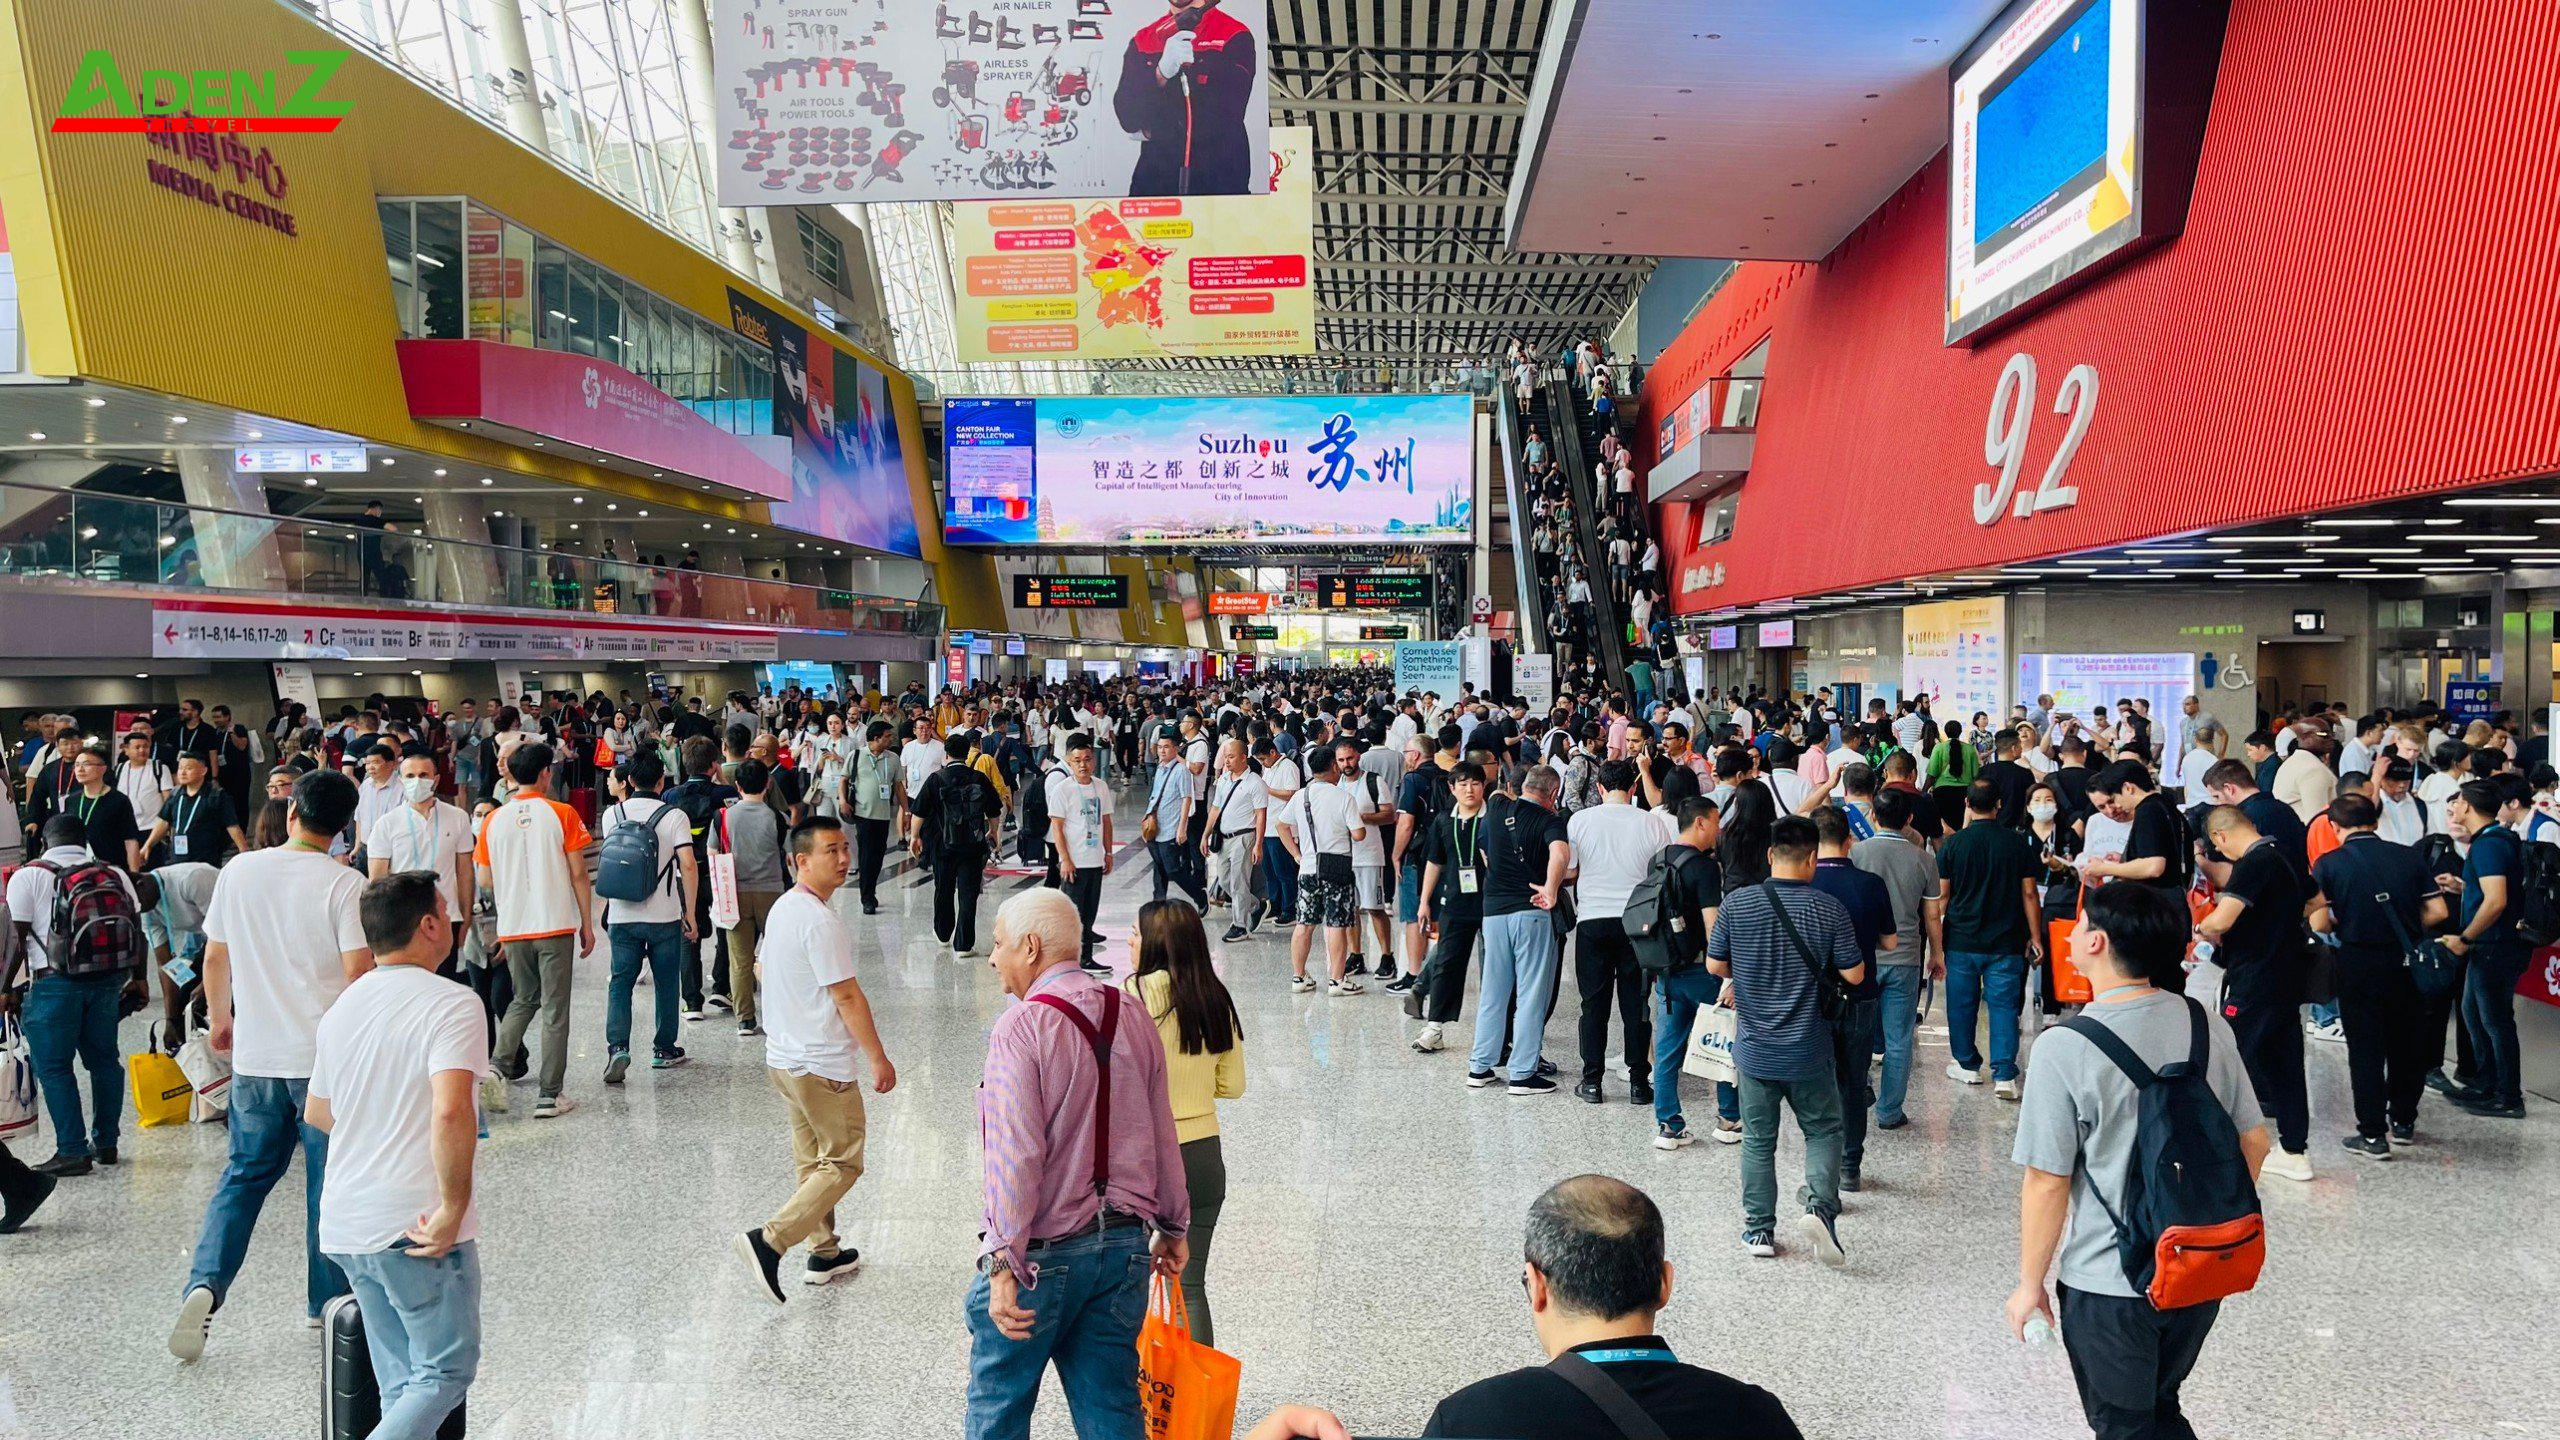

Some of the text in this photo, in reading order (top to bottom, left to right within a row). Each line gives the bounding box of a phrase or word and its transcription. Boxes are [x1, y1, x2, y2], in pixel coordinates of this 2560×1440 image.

[993, 1, 1051, 11] AIR NAILER
[788, 8, 848, 18] SPRAY GUN
[984, 59, 1029, 68] AIRLESS
[983, 71, 1034, 81] SPRAYER
[790, 98, 844, 107] AIR TOOLS
[780, 110, 854, 119] POWER TOOLS
[147, 159, 297, 237] MEDIA CENTRE
[1971, 351, 2101, 526] 9.2
[1307, 413, 1416, 494] 苏州
[1093, 459, 1289, 480] 智造之都 创新之城
[1095, 481, 1242, 493] Capital of Intelligent Manufacturing
[1214, 493, 1288, 502] City of Innovation
[458, 632, 470, 648] 2F
[1402, 647, 1429, 655] Come
[1402, 655, 1453, 665] Something
